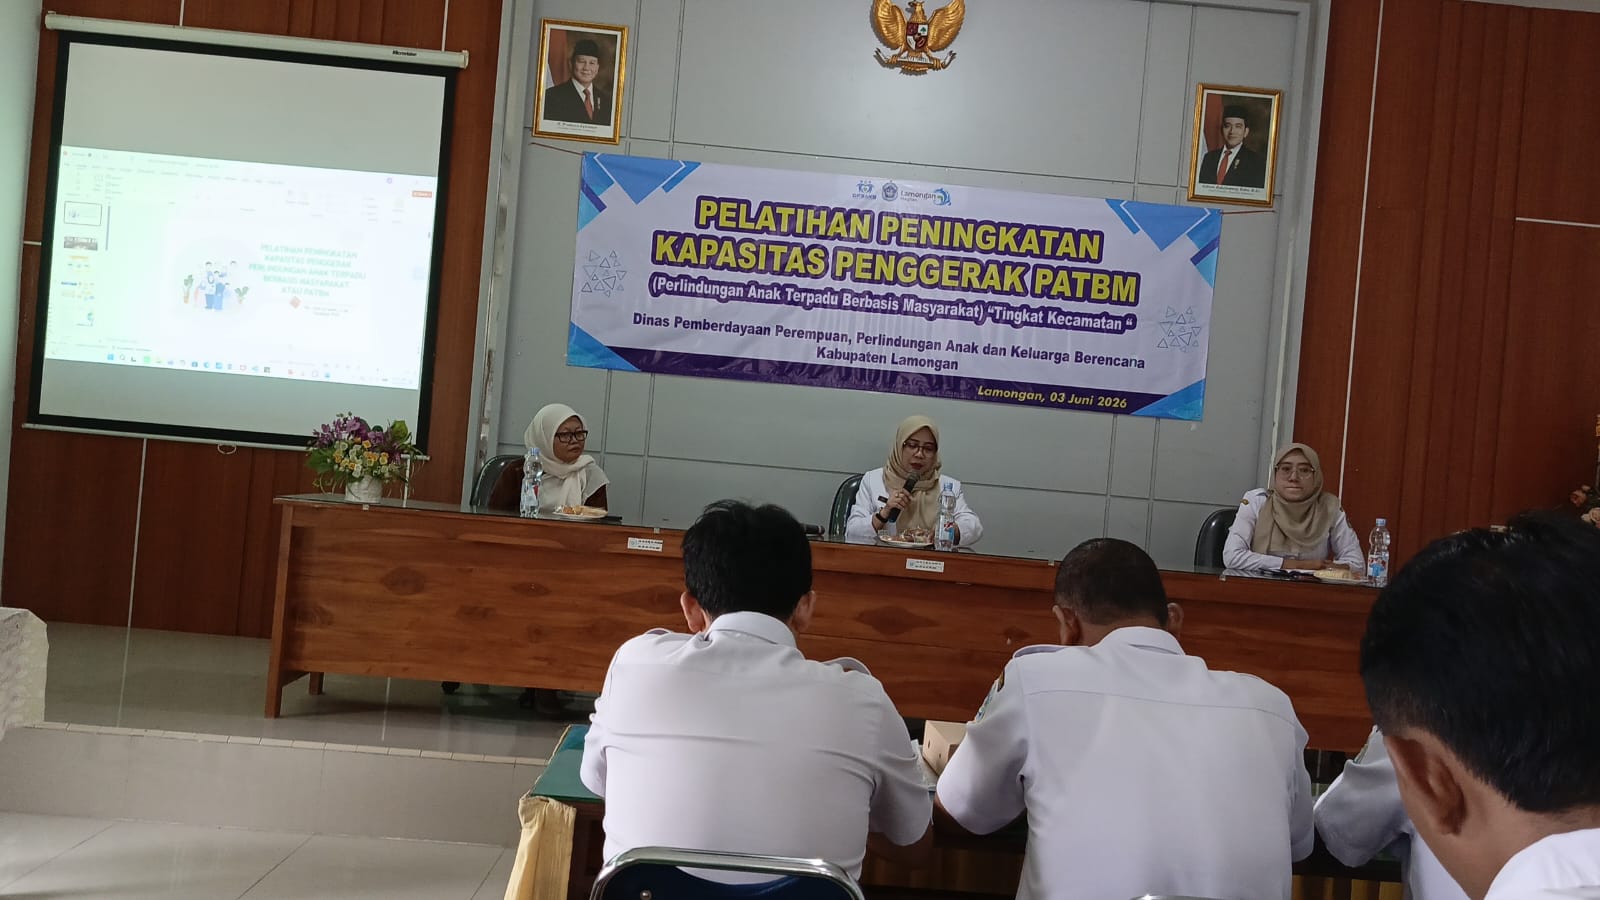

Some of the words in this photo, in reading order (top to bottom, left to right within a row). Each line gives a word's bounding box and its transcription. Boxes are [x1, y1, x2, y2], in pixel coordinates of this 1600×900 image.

[699, 200, 870, 239] PELATIHAN
[881, 216, 1100, 260] PENINGKATAN
[655, 235, 825, 275] KAPASITAS
[836, 251, 1025, 293] PENGGERAK
[1034, 268, 1137, 302] PATBM
[652, 276, 744, 299] (Perlindungan
[747, 285, 781, 300] Anak
[785, 288, 838, 307] Terpadu
[842, 293, 899, 311] Berbasis
[903, 299, 984, 320] Masyarakat)
[1047, 311, 1122, 331] Kecamatan
[633, 312, 670, 328] Dinas
[674, 317, 771, 339] Pemberdayaan
[775, 325, 852, 346] Perempuan,
[856, 331, 942, 353] Perlindungan
[945, 339, 979, 354] Anak
[982, 342, 1006, 357] dan
[1011, 345, 1070, 364] Keluarga
[1074, 350, 1145, 369] Berencana
[816, 347, 887, 366] Kabupaten
[891, 353, 959, 371] Lamongan
[977, 385, 1045, 403] Lamongan,
[1049, 391, 1065, 404] 03
[1068, 393, 1094, 406] Juni
[1097, 396, 1127, 409] 2026
